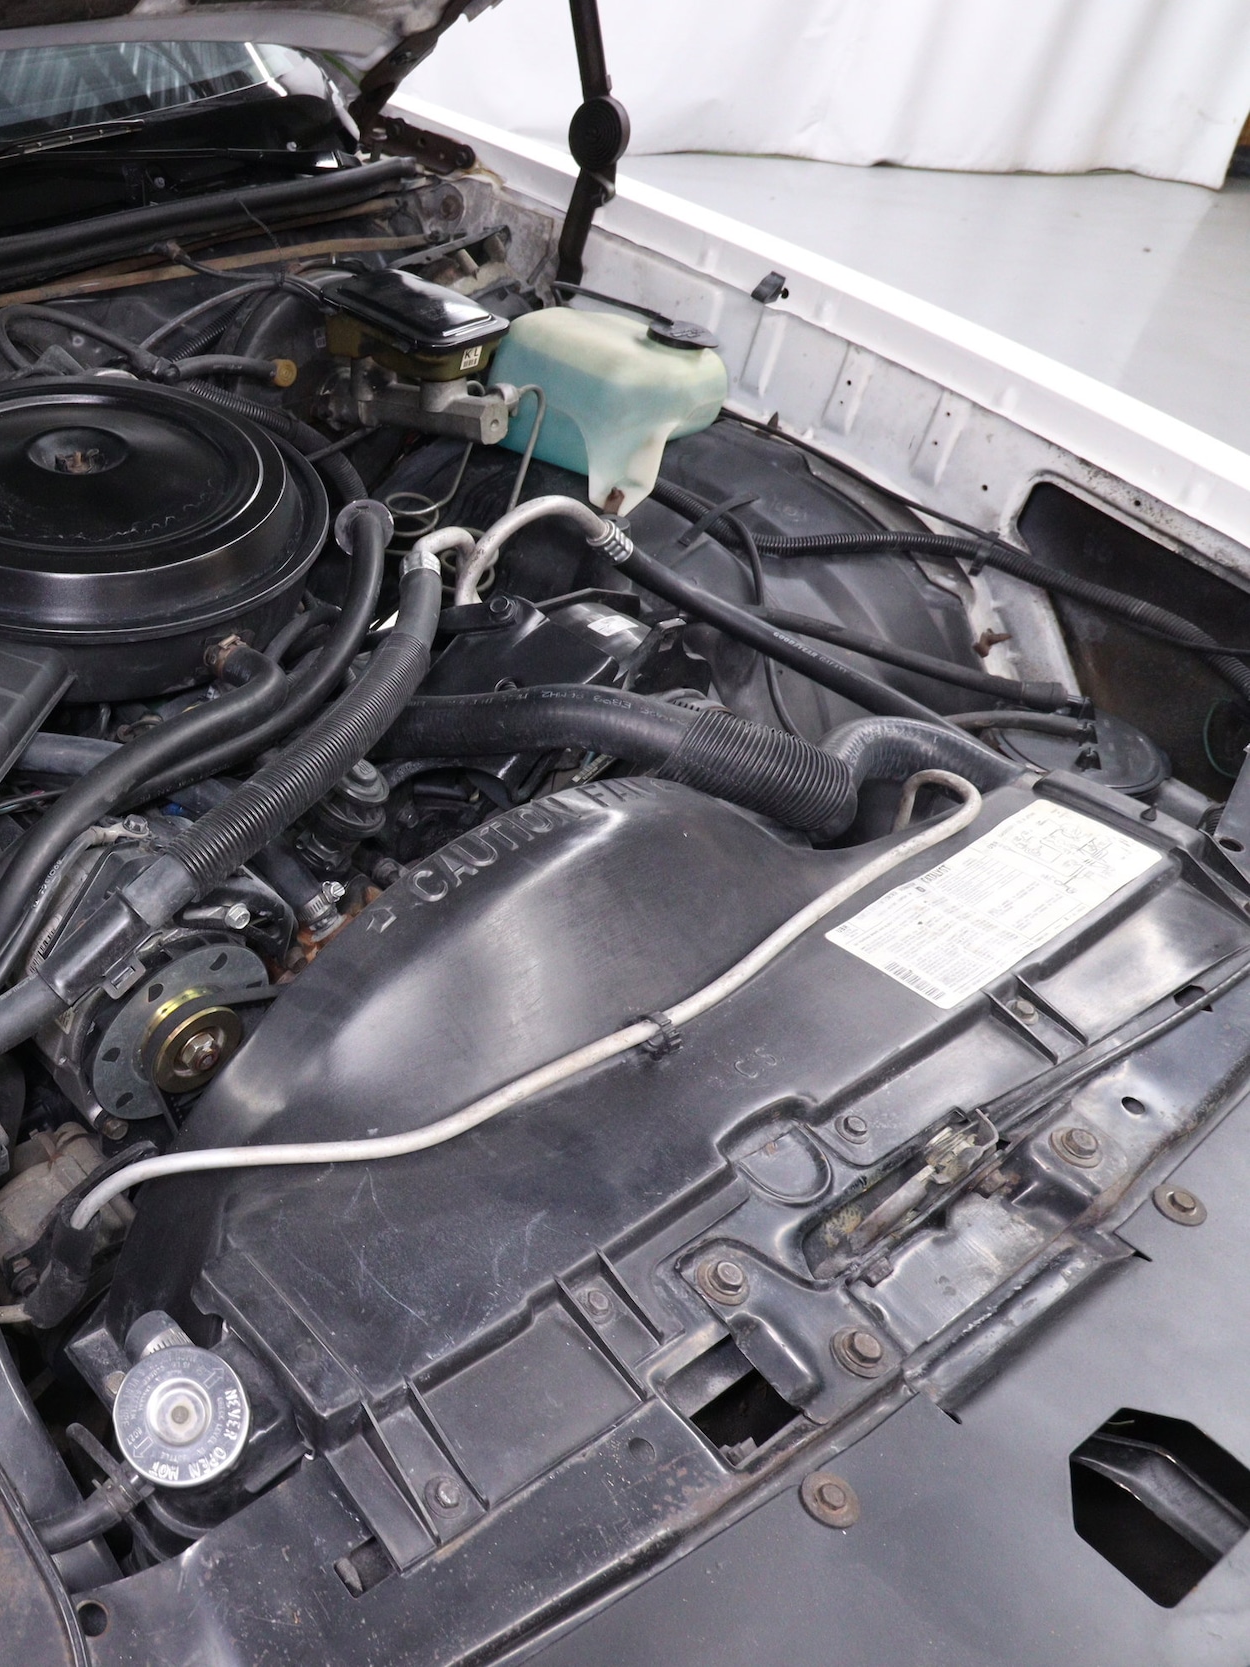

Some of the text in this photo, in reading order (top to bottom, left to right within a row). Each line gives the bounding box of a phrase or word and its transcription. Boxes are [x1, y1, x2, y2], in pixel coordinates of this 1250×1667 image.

[772, 630, 817, 658] GOODYEAR
[410, 795, 582, 902] CAUTION
[149, 1389, 241, 1480] NEVER OPEN HOT
